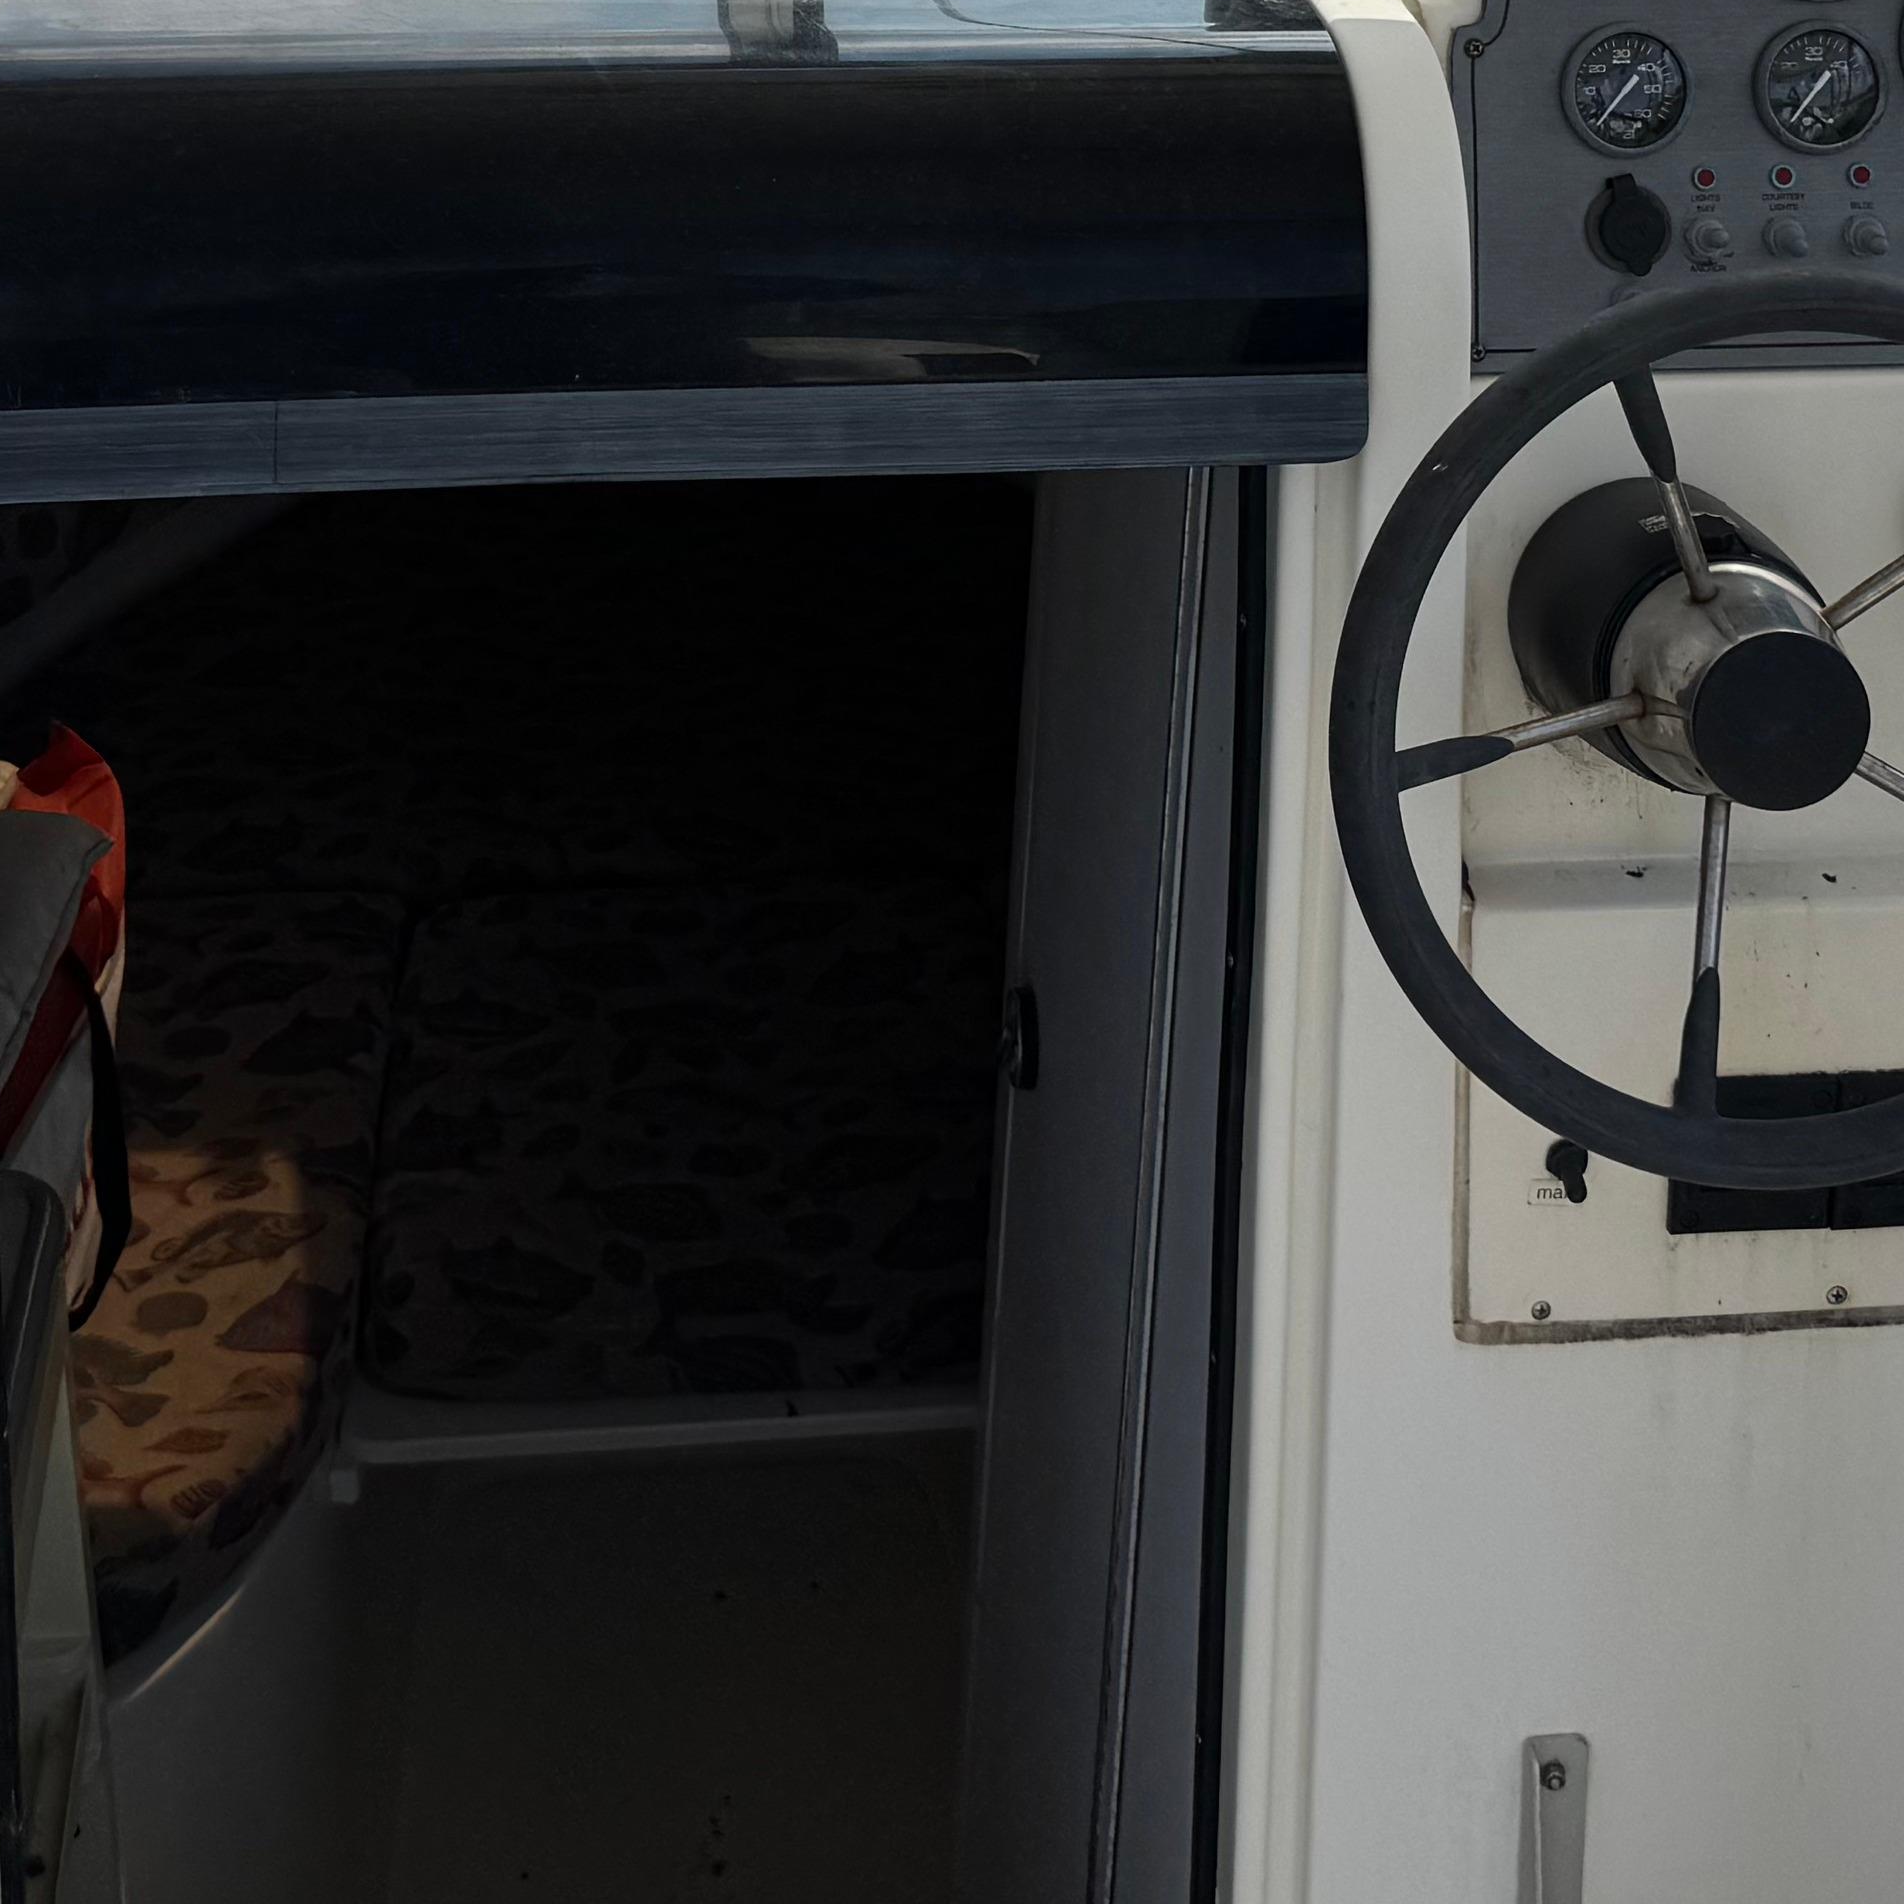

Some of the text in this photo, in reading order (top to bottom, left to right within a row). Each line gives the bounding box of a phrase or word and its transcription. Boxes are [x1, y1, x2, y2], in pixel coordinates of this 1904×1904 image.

[1612, 49, 1631, 60] 30
[1804, 46, 1823, 57] 30
[1690, 193, 1721, 203] LIGHTS
